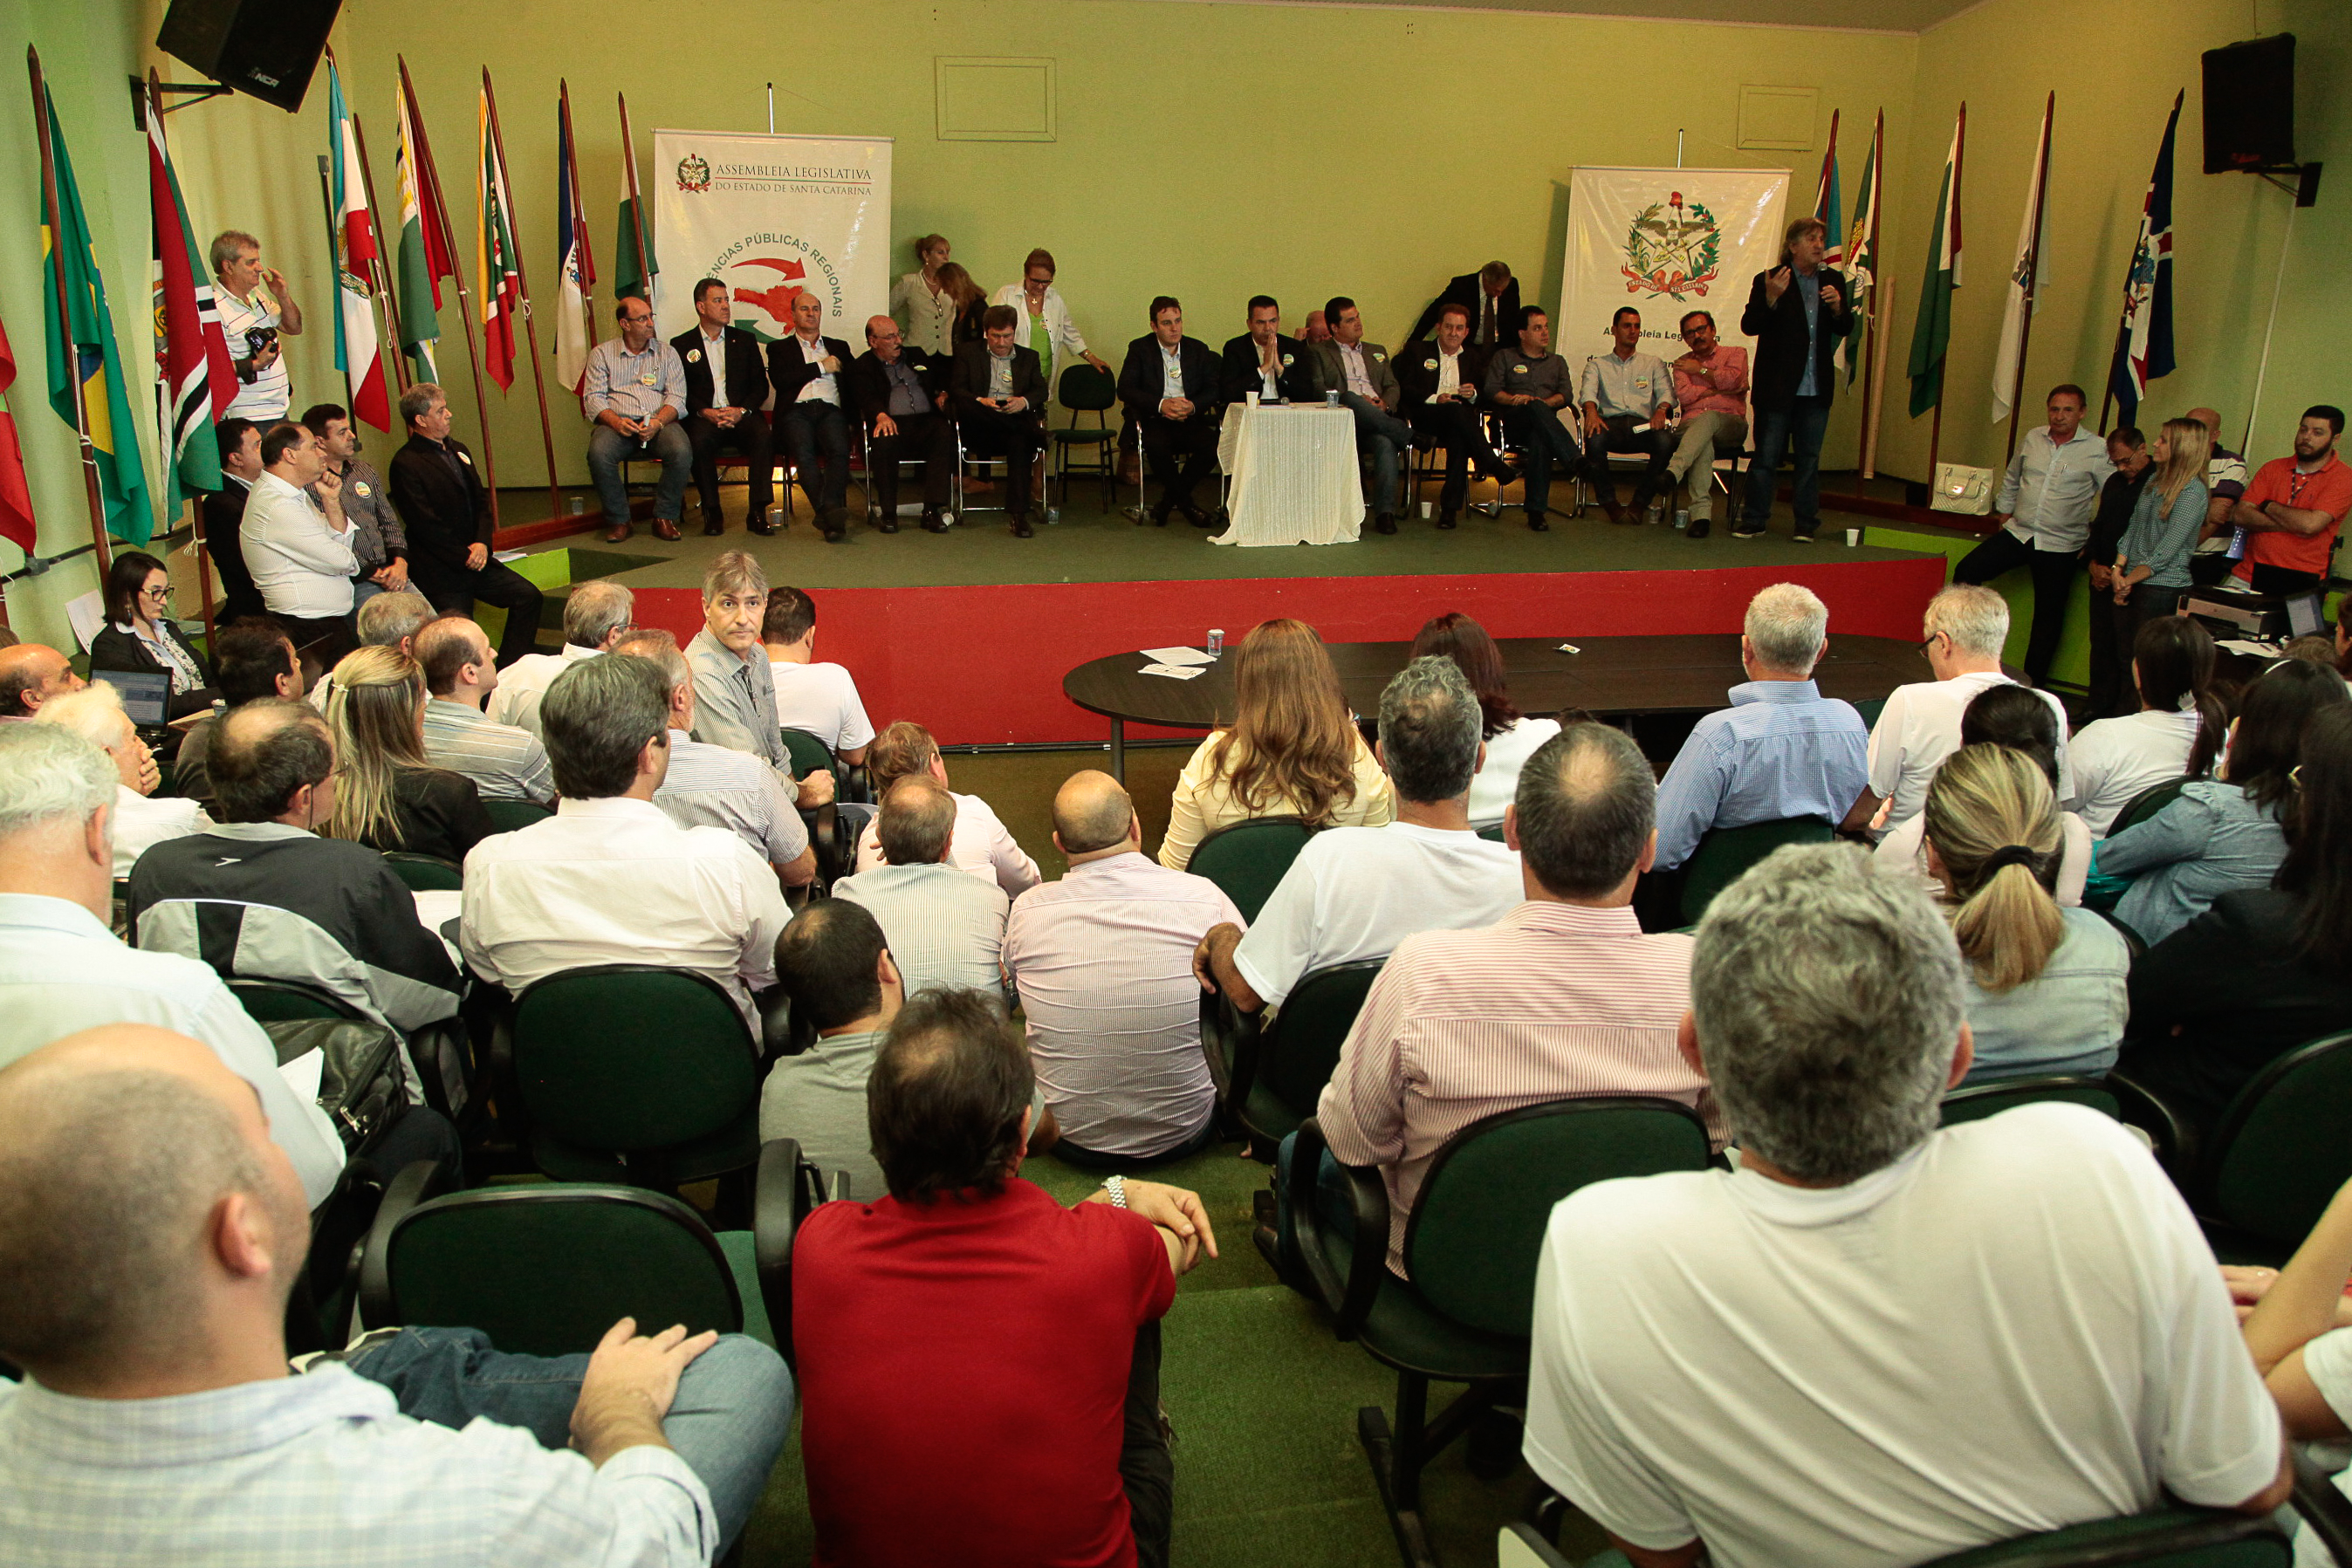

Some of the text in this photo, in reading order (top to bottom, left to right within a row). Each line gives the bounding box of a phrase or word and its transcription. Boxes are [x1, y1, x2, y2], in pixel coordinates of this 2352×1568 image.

[717, 164, 871, 180] ASSEMBLEIA LEGISLATIVA
[716, 182, 872, 196] DO ESTADO DE SANTA CATARINA
[745, 232, 809, 252] PÚBLICAS
[810, 249, 843, 318] REGIONAIS
